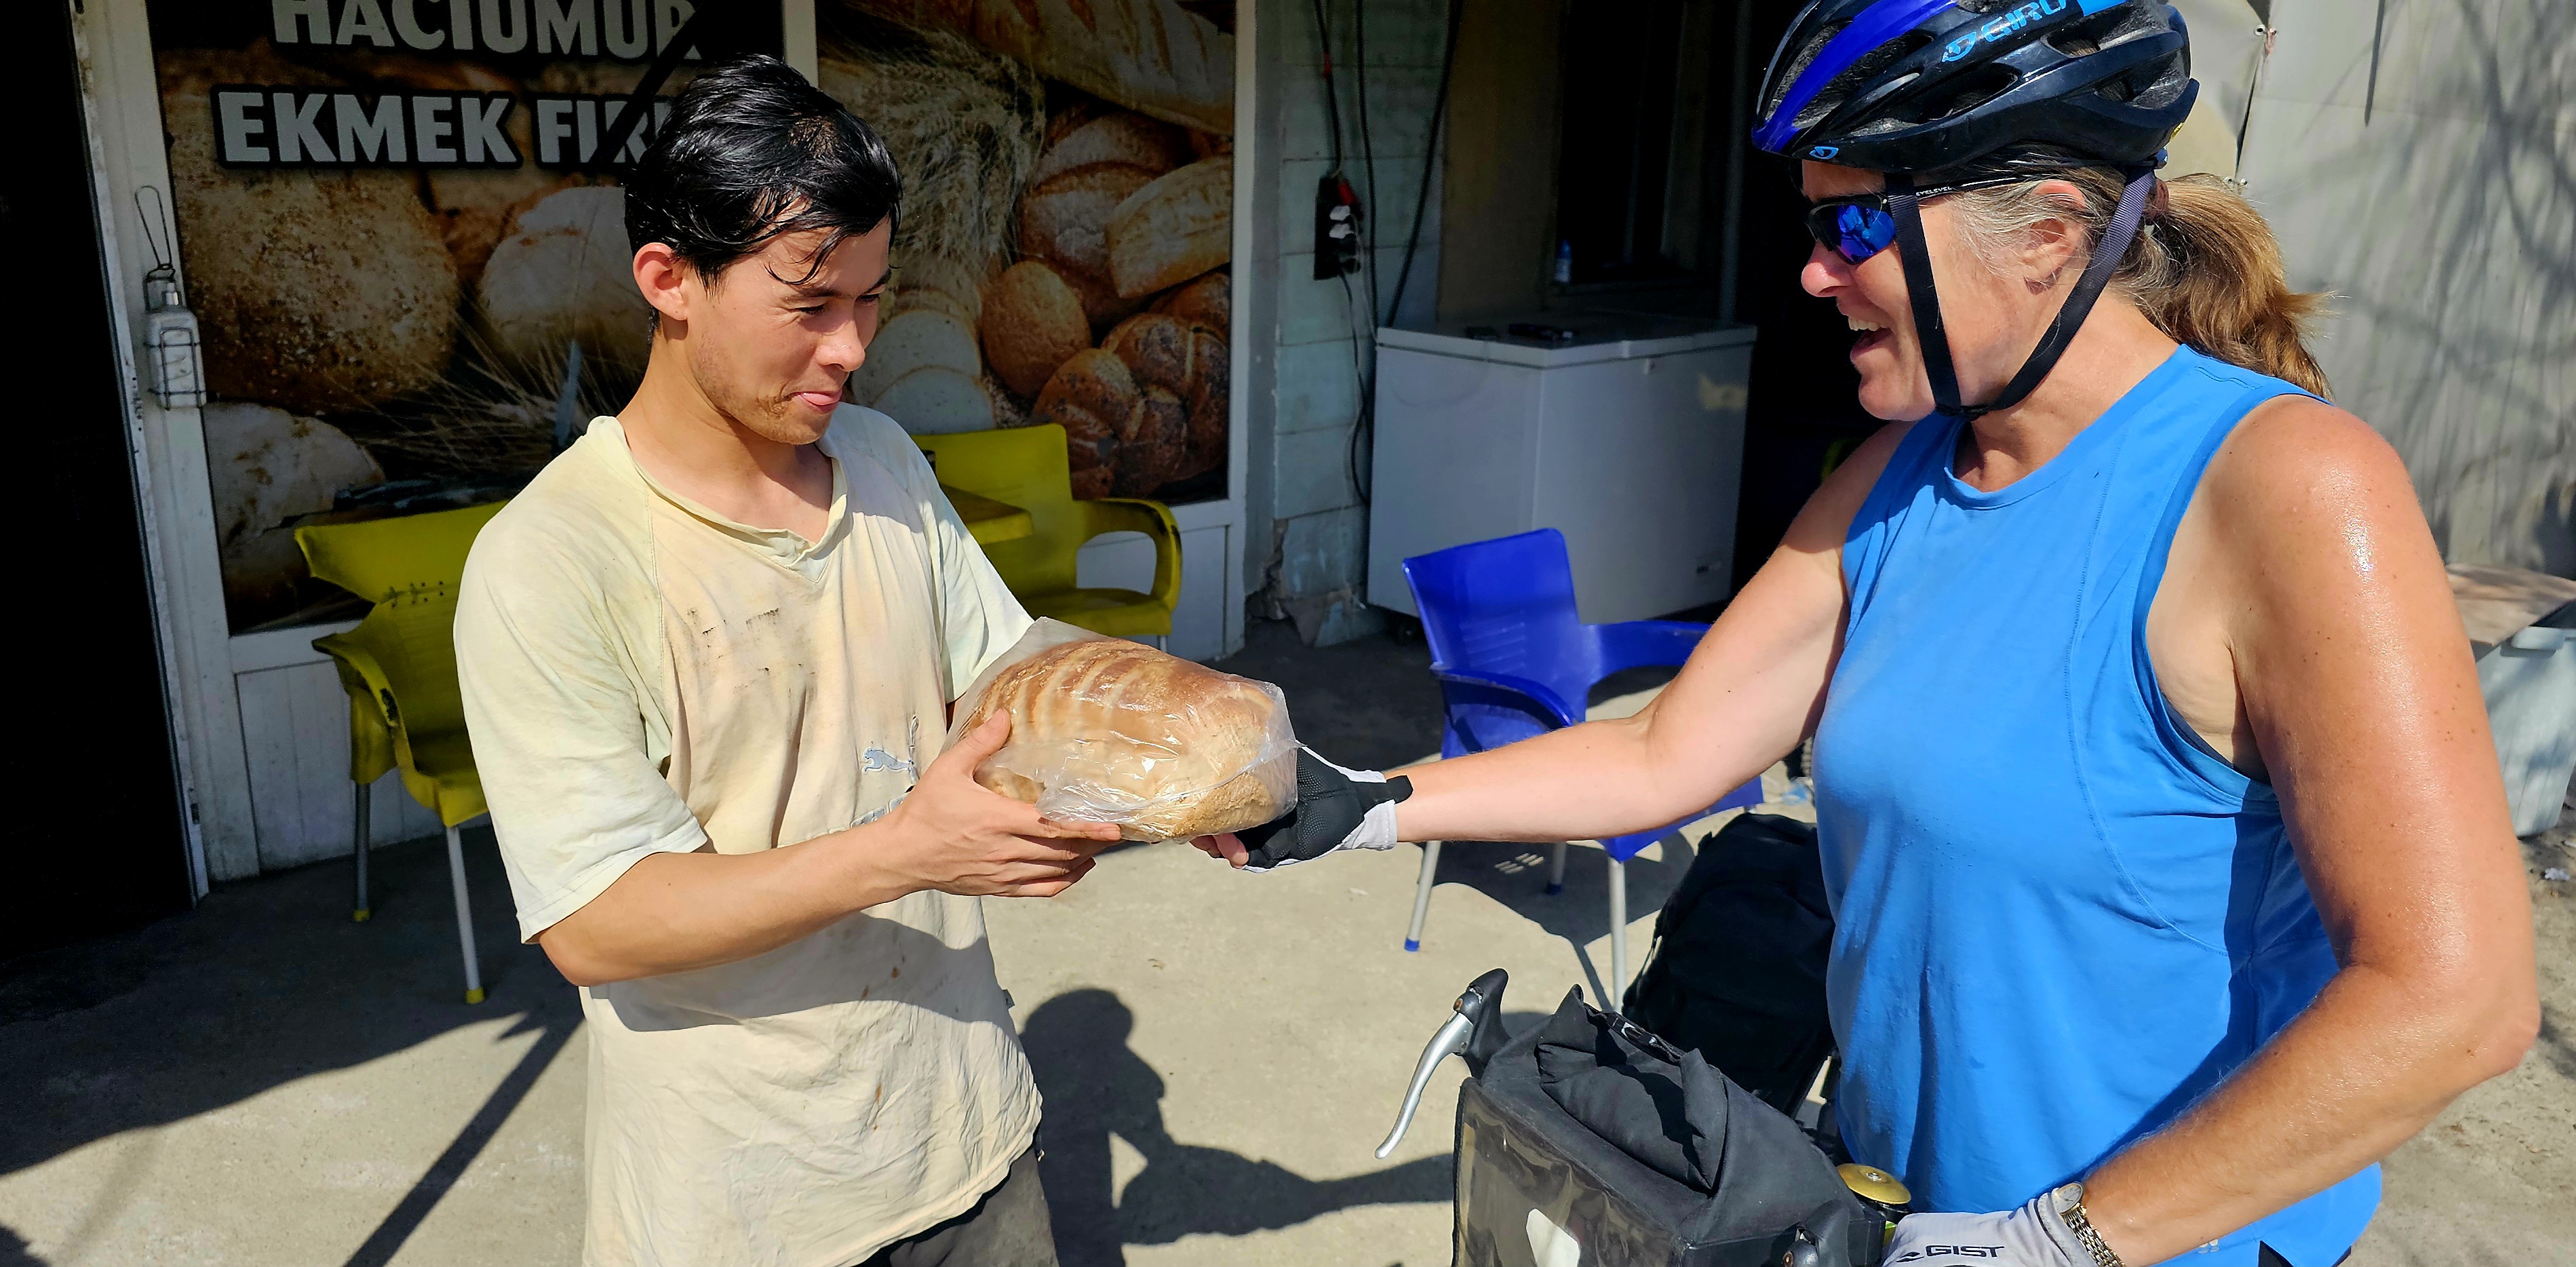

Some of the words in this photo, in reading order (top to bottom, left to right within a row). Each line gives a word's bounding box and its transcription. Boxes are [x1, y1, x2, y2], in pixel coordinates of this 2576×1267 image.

[1980, 0, 2067, 42] GIRO
[218, 92, 518, 163] EKMEK
[1915, 186, 1952, 197] EYELEVEL
[1925, 1245, 2005, 1258] GIST
